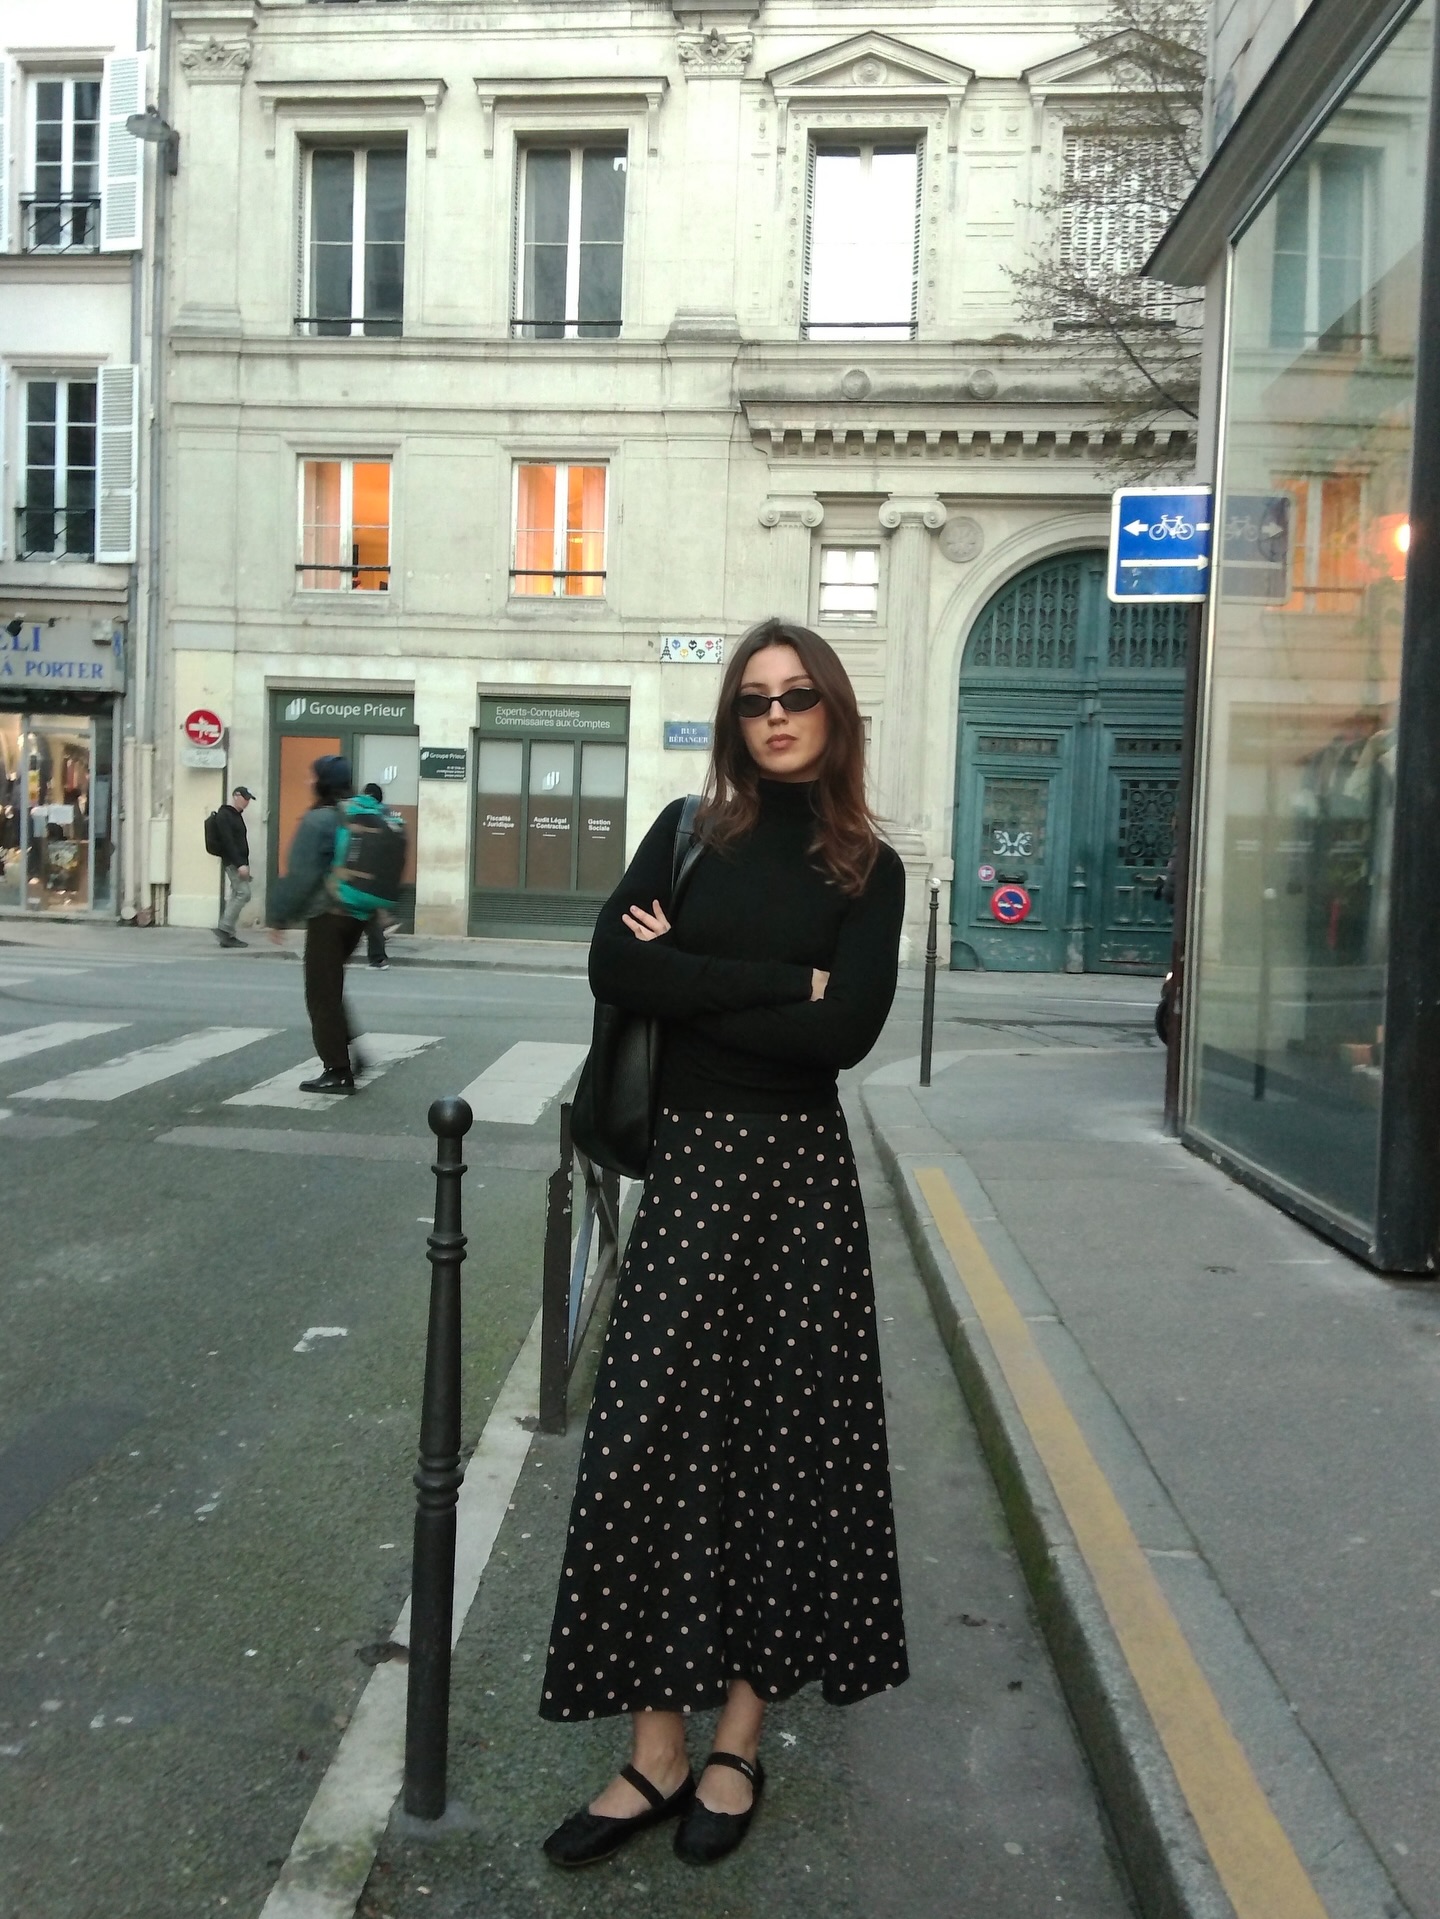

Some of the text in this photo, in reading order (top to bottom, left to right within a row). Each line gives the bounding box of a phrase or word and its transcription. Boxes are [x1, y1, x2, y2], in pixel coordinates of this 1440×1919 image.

[25, 660, 103, 679] PORTER
[309, 701, 406, 718] Groupe Prieur
[496, 706, 580, 719] Experts-Comptables
[495, 715, 611, 730] Commissaires aux Comptes
[669, 734, 708, 743] BÉRANGER
[487, 821, 514, 829] Juridique
[533, 816, 567, 825] Audit Légal
[587, 818, 611, 826] Gestion
